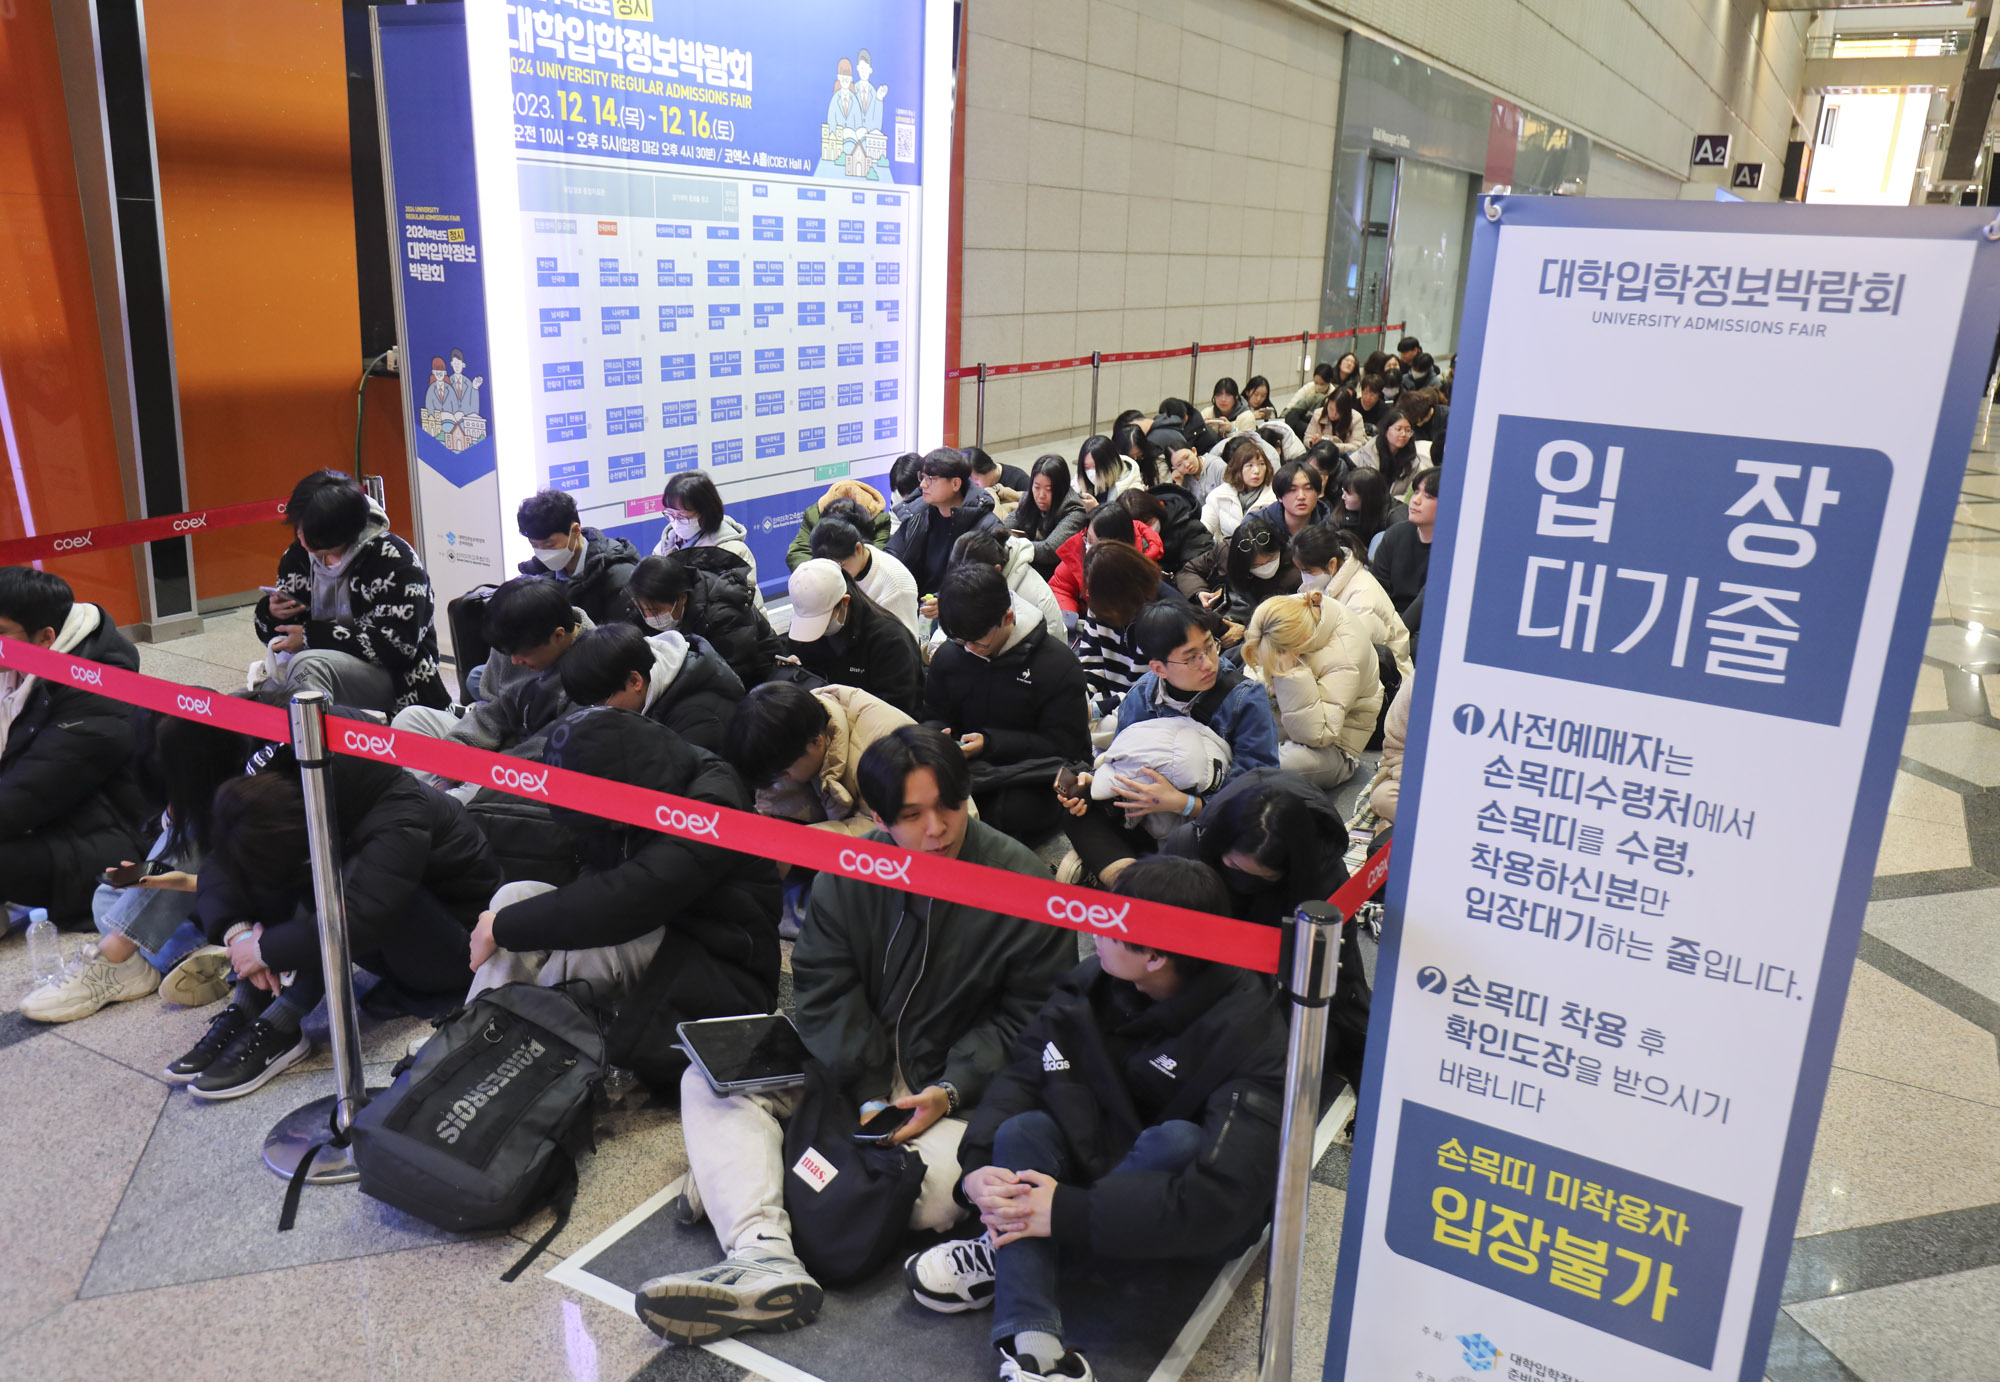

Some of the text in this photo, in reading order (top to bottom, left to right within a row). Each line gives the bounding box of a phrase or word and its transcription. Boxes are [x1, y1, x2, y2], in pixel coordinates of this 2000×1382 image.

[509, 56, 752, 109] 024 UNIVERSITY REGULAR ADMISSIONS FAIR
[557, 90, 587, 123] 12.
[659, 105, 685, 135] 12.
[514, 124, 537, 143] 오전
[540, 128, 564, 146] 10시
[577, 131, 599, 149] 오후
[661, 142, 678, 157] 오후
[680, 145, 694, 159] 4시
[724, 149, 751, 165] 코엑스
[1695, 138, 1725, 162] A2
[1735, 165, 1758, 186] A1
[407, 241, 477, 263] 대학입학정보
[449, 230, 464, 241] 정시
[409, 263, 445, 282] 박람회
[1538, 258, 1907, 316] 대학입학정보박람회
[1592, 311, 1827, 337] UNIVERSITY ADMISSIONS FAIR
[173, 513, 207, 531] coex
[54, 531, 93, 551] coex
[1517, 555, 1800, 684] 대기줄
[71, 664, 103, 686] coex
[177, 694, 212, 716] coex
[344, 730, 397, 758] coex
[1488, 708, 1694, 776] 사전예매자는
[491, 765, 549, 796] coex
[1483, 754, 1756, 840] 손목띠수령처에서
[655, 805, 720, 839] coex
[1476, 800, 1695, 878] 손목띠를 수령,
[839, 849, 912, 885] coex
[1470, 841, 1671, 917] 착용하신분만
[1046, 896, 1131, 933] coex
[1464, 886, 1803, 1001] 입장대기하는 줄입니다.
[1452, 974, 1549, 1027] 손목띠
[1559, 1001, 1628, 1049] 착용
[1637, 1027, 1667, 1056] 후
[1043, 1059, 1070, 1072] ddas
[1444, 1013, 1731, 1125] 확인도장을 받으시기
[1439, 1058, 1546, 1113] 바랍니다
[799, 1152, 829, 1185] mas.
[1437, 1137, 1690, 1247] 손목띠 미착용자
[1431, 1186, 1680, 1323] 입장불가
